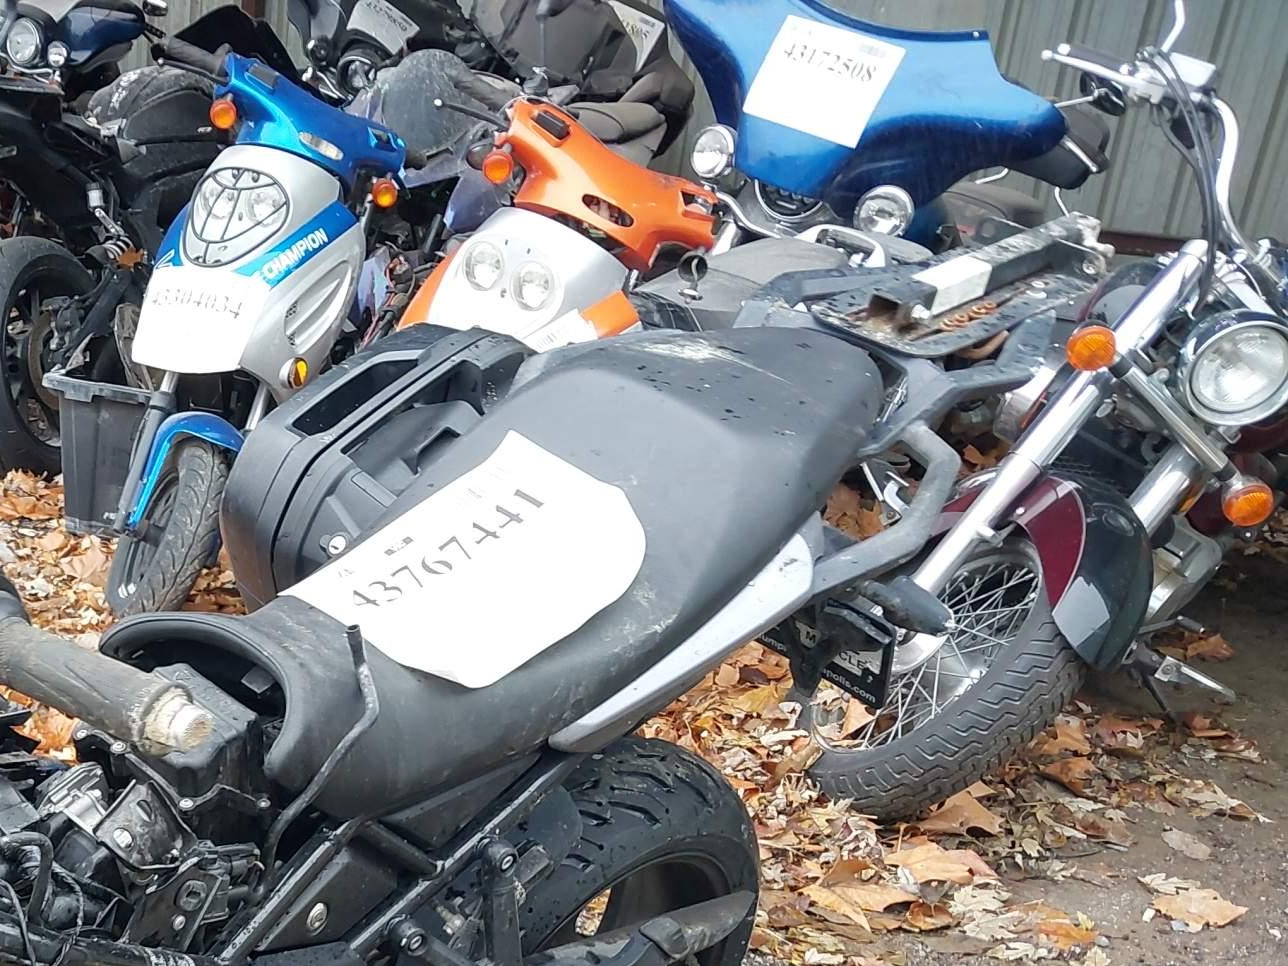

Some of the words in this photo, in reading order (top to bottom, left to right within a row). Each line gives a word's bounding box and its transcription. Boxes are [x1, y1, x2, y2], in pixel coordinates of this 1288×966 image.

[263, 227, 329, 280] CHAMPION
[352, 487, 545, 607] 43767441
[839, 650, 866, 670] CLE
[823, 668, 876, 703] polis.com
